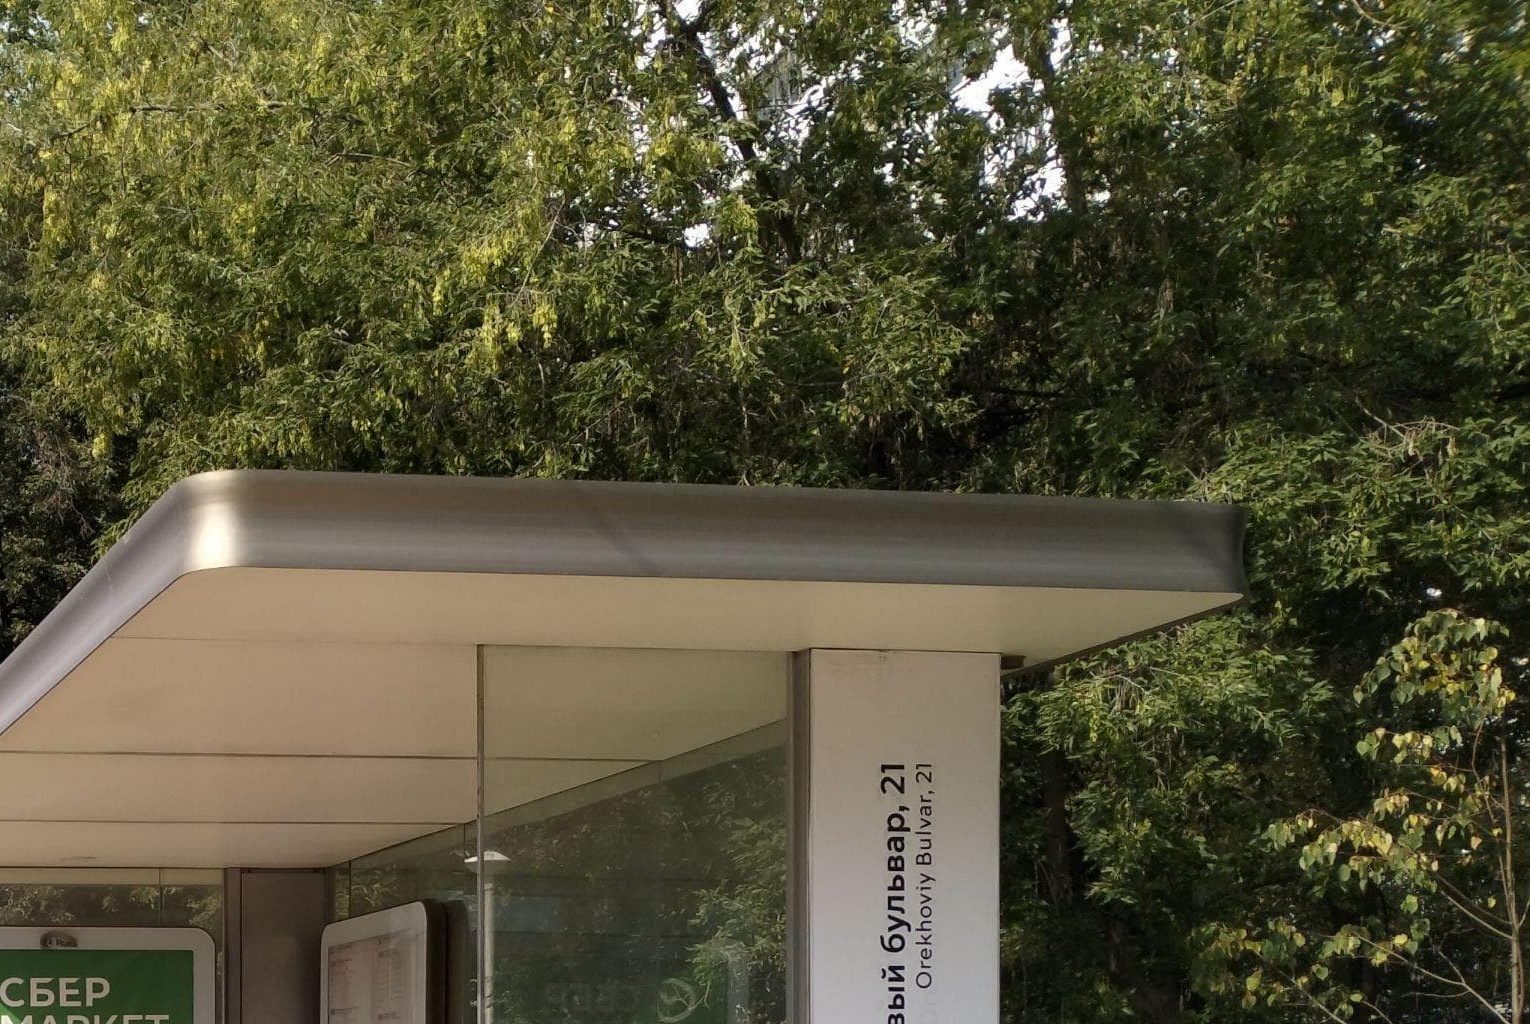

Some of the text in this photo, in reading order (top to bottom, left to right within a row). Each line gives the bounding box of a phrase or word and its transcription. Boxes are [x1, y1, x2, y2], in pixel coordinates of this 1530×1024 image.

[880, 763, 906, 795] 21
[915, 763, 933, 786] 21
[915, 788, 935, 867] Bulvar,
[880, 805, 911, 952] бульвар,
[915, 872, 936, 990] Orekhoviy
